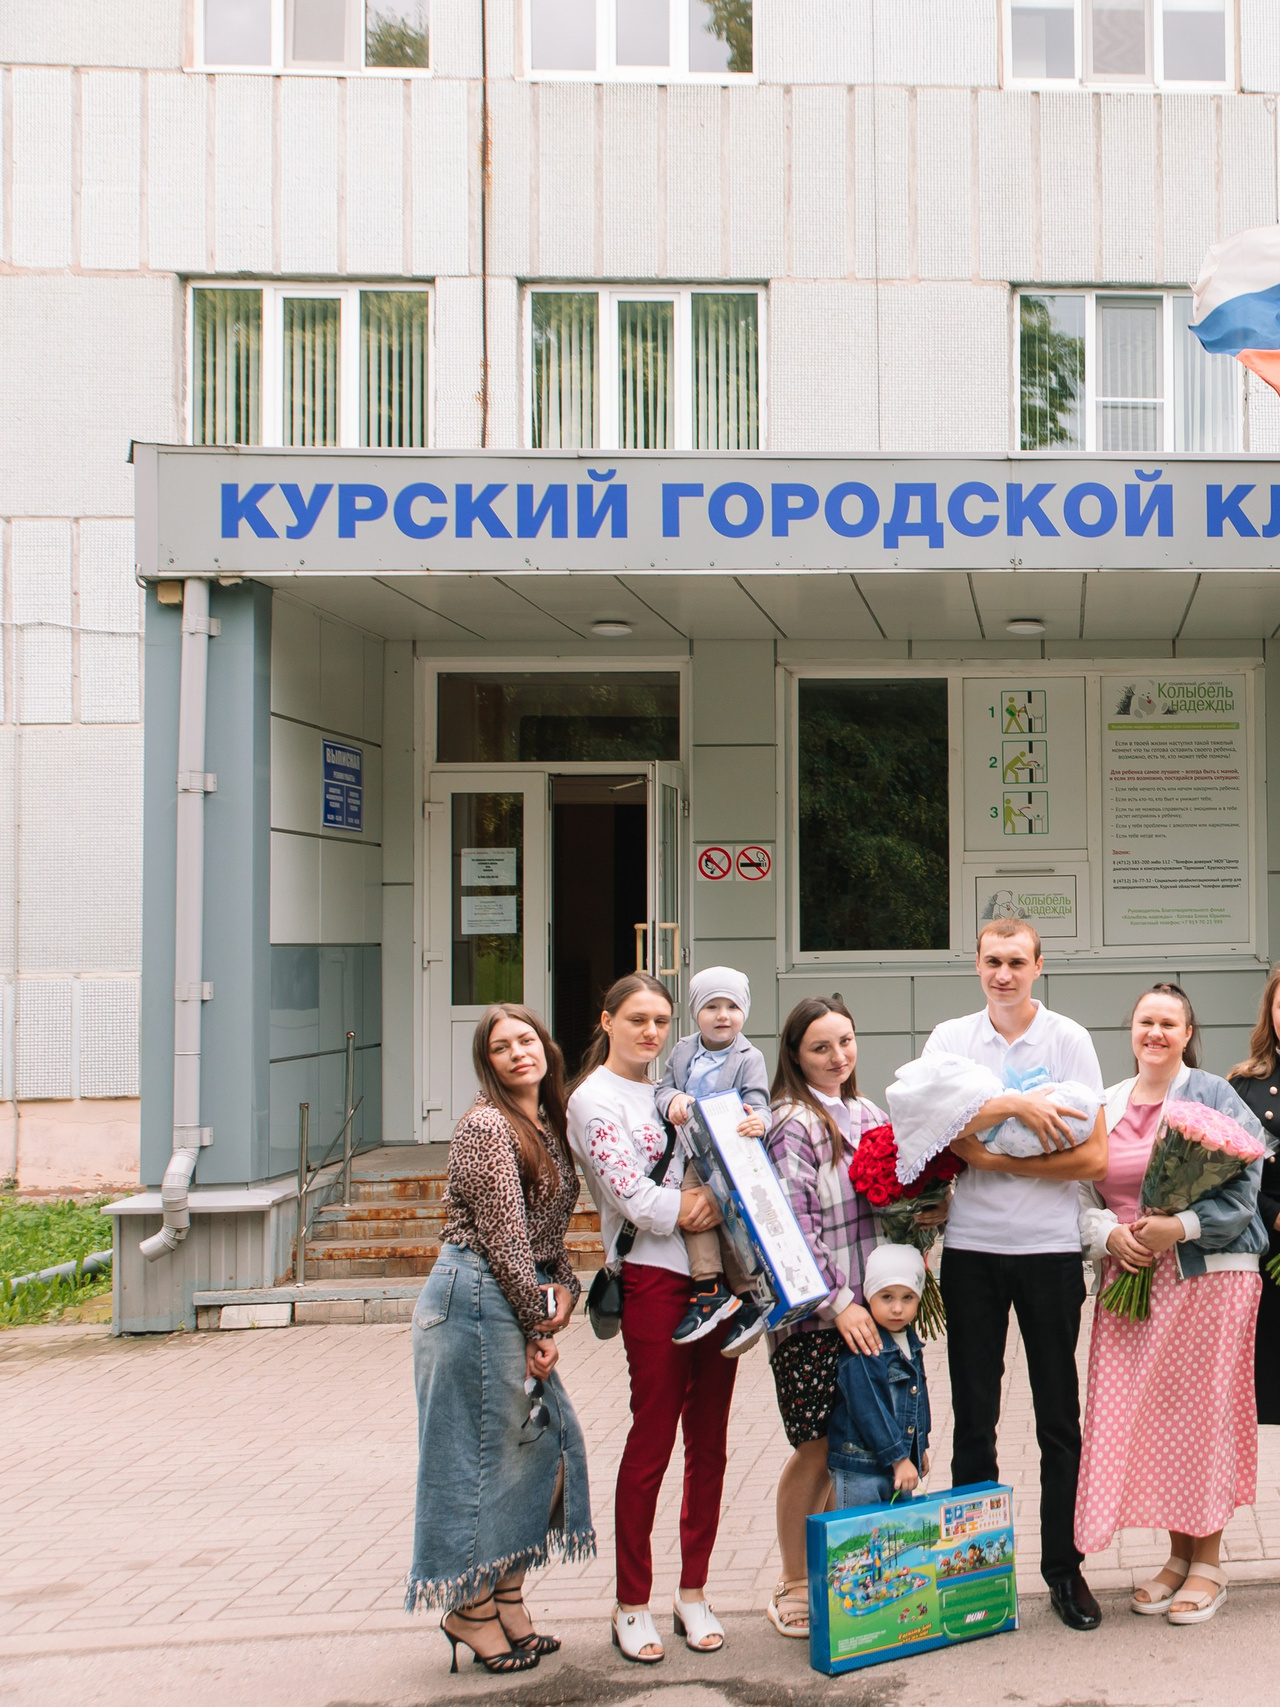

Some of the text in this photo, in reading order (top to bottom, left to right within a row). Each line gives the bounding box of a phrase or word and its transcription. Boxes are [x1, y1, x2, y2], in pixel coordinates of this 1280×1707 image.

[221, 469, 627, 539] КУРСКИЙ
[662, 470, 1173, 548] ГОРОДСКОЙ
[1158, 682, 1234, 698] Колыбель
[988, 706, 995, 718] 1
[1170, 700, 1235, 713] надежды
[988, 756, 998, 768] 2
[989, 806, 999, 818] 3
[1018, 894, 1071, 906] Колыбель
[1027, 906, 1072, 915] надежды
